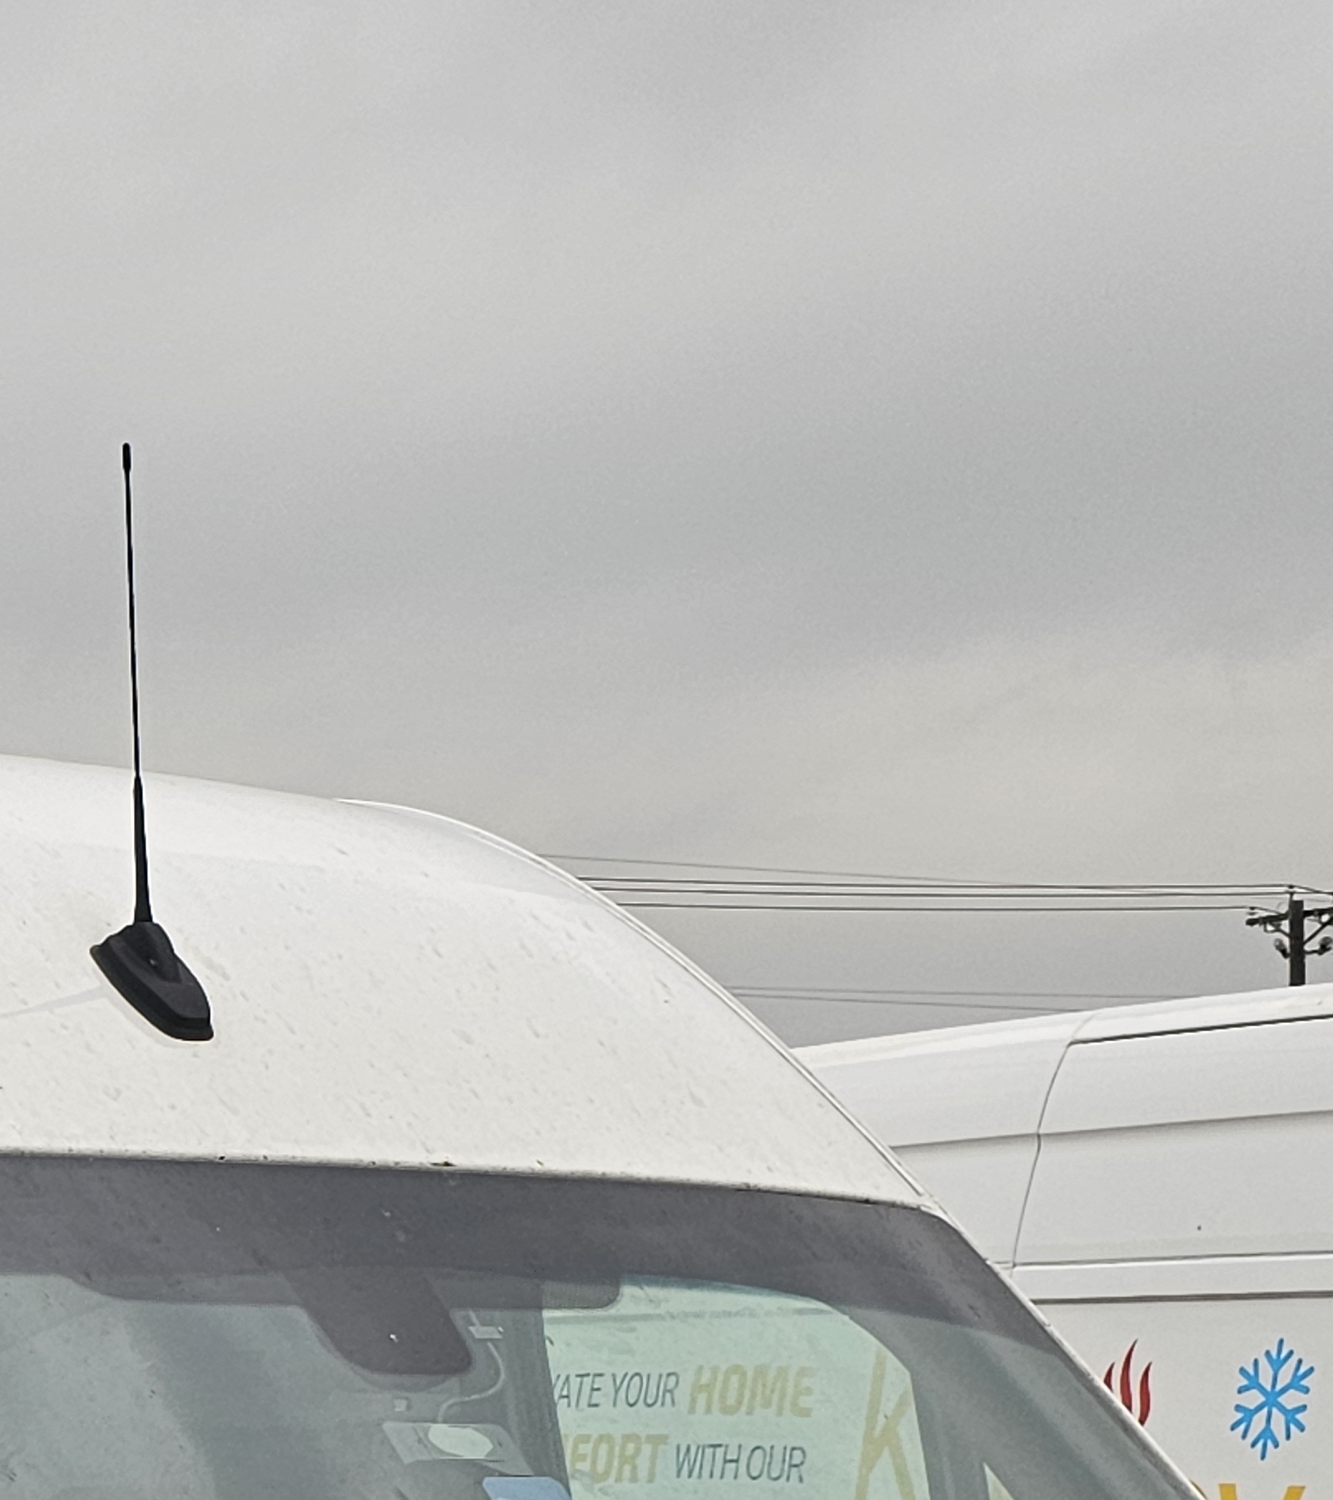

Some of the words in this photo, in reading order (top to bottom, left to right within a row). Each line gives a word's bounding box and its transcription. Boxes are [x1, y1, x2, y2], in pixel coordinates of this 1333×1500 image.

[611, 1371, 680, 1408] YOUR
[687, 1364, 815, 1418] HOME
[563, 1433, 669, 1485] FORT
[675, 1443, 742, 1480] WITH
[745, 1445, 807, 1484] OUR
